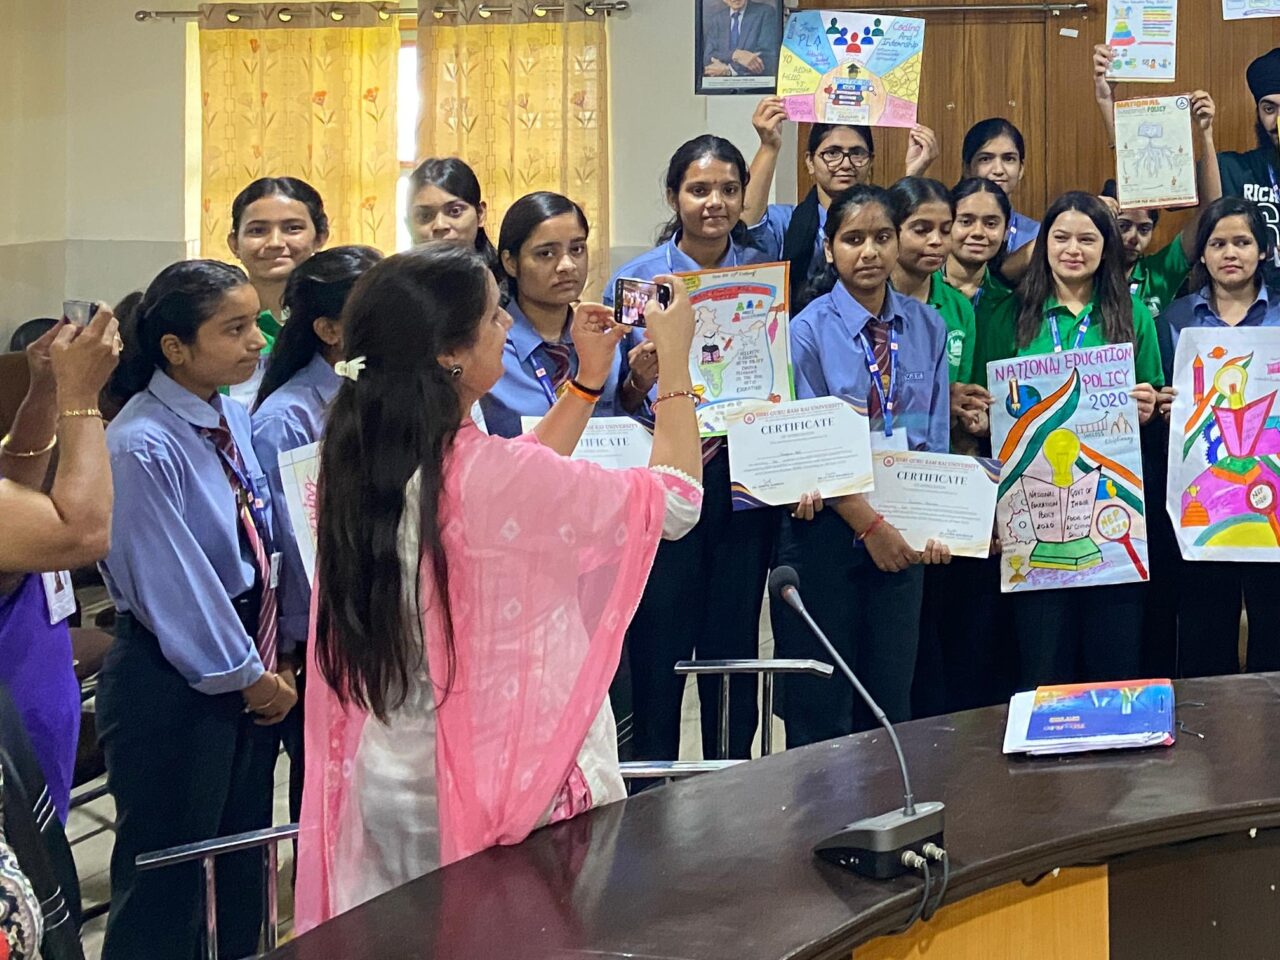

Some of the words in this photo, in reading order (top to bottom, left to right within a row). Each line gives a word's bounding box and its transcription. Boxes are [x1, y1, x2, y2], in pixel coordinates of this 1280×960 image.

[995, 357, 1061, 381] NATIONAL
[1064, 346, 1132, 369] EDUCATION
[1082, 369, 1130, 394] POLICY
[811, 402, 844, 411] UNIVERSITY
[1089, 391, 1129, 411] 2020
[761, 417, 835, 435] CERTIFICATE
[580, 436, 630, 448] TIFICATE
[948, 461, 980, 470] UNIVERSITY
[897, 470, 969, 486] CERTIFICATE
[1101, 509, 1119, 529] NEP
